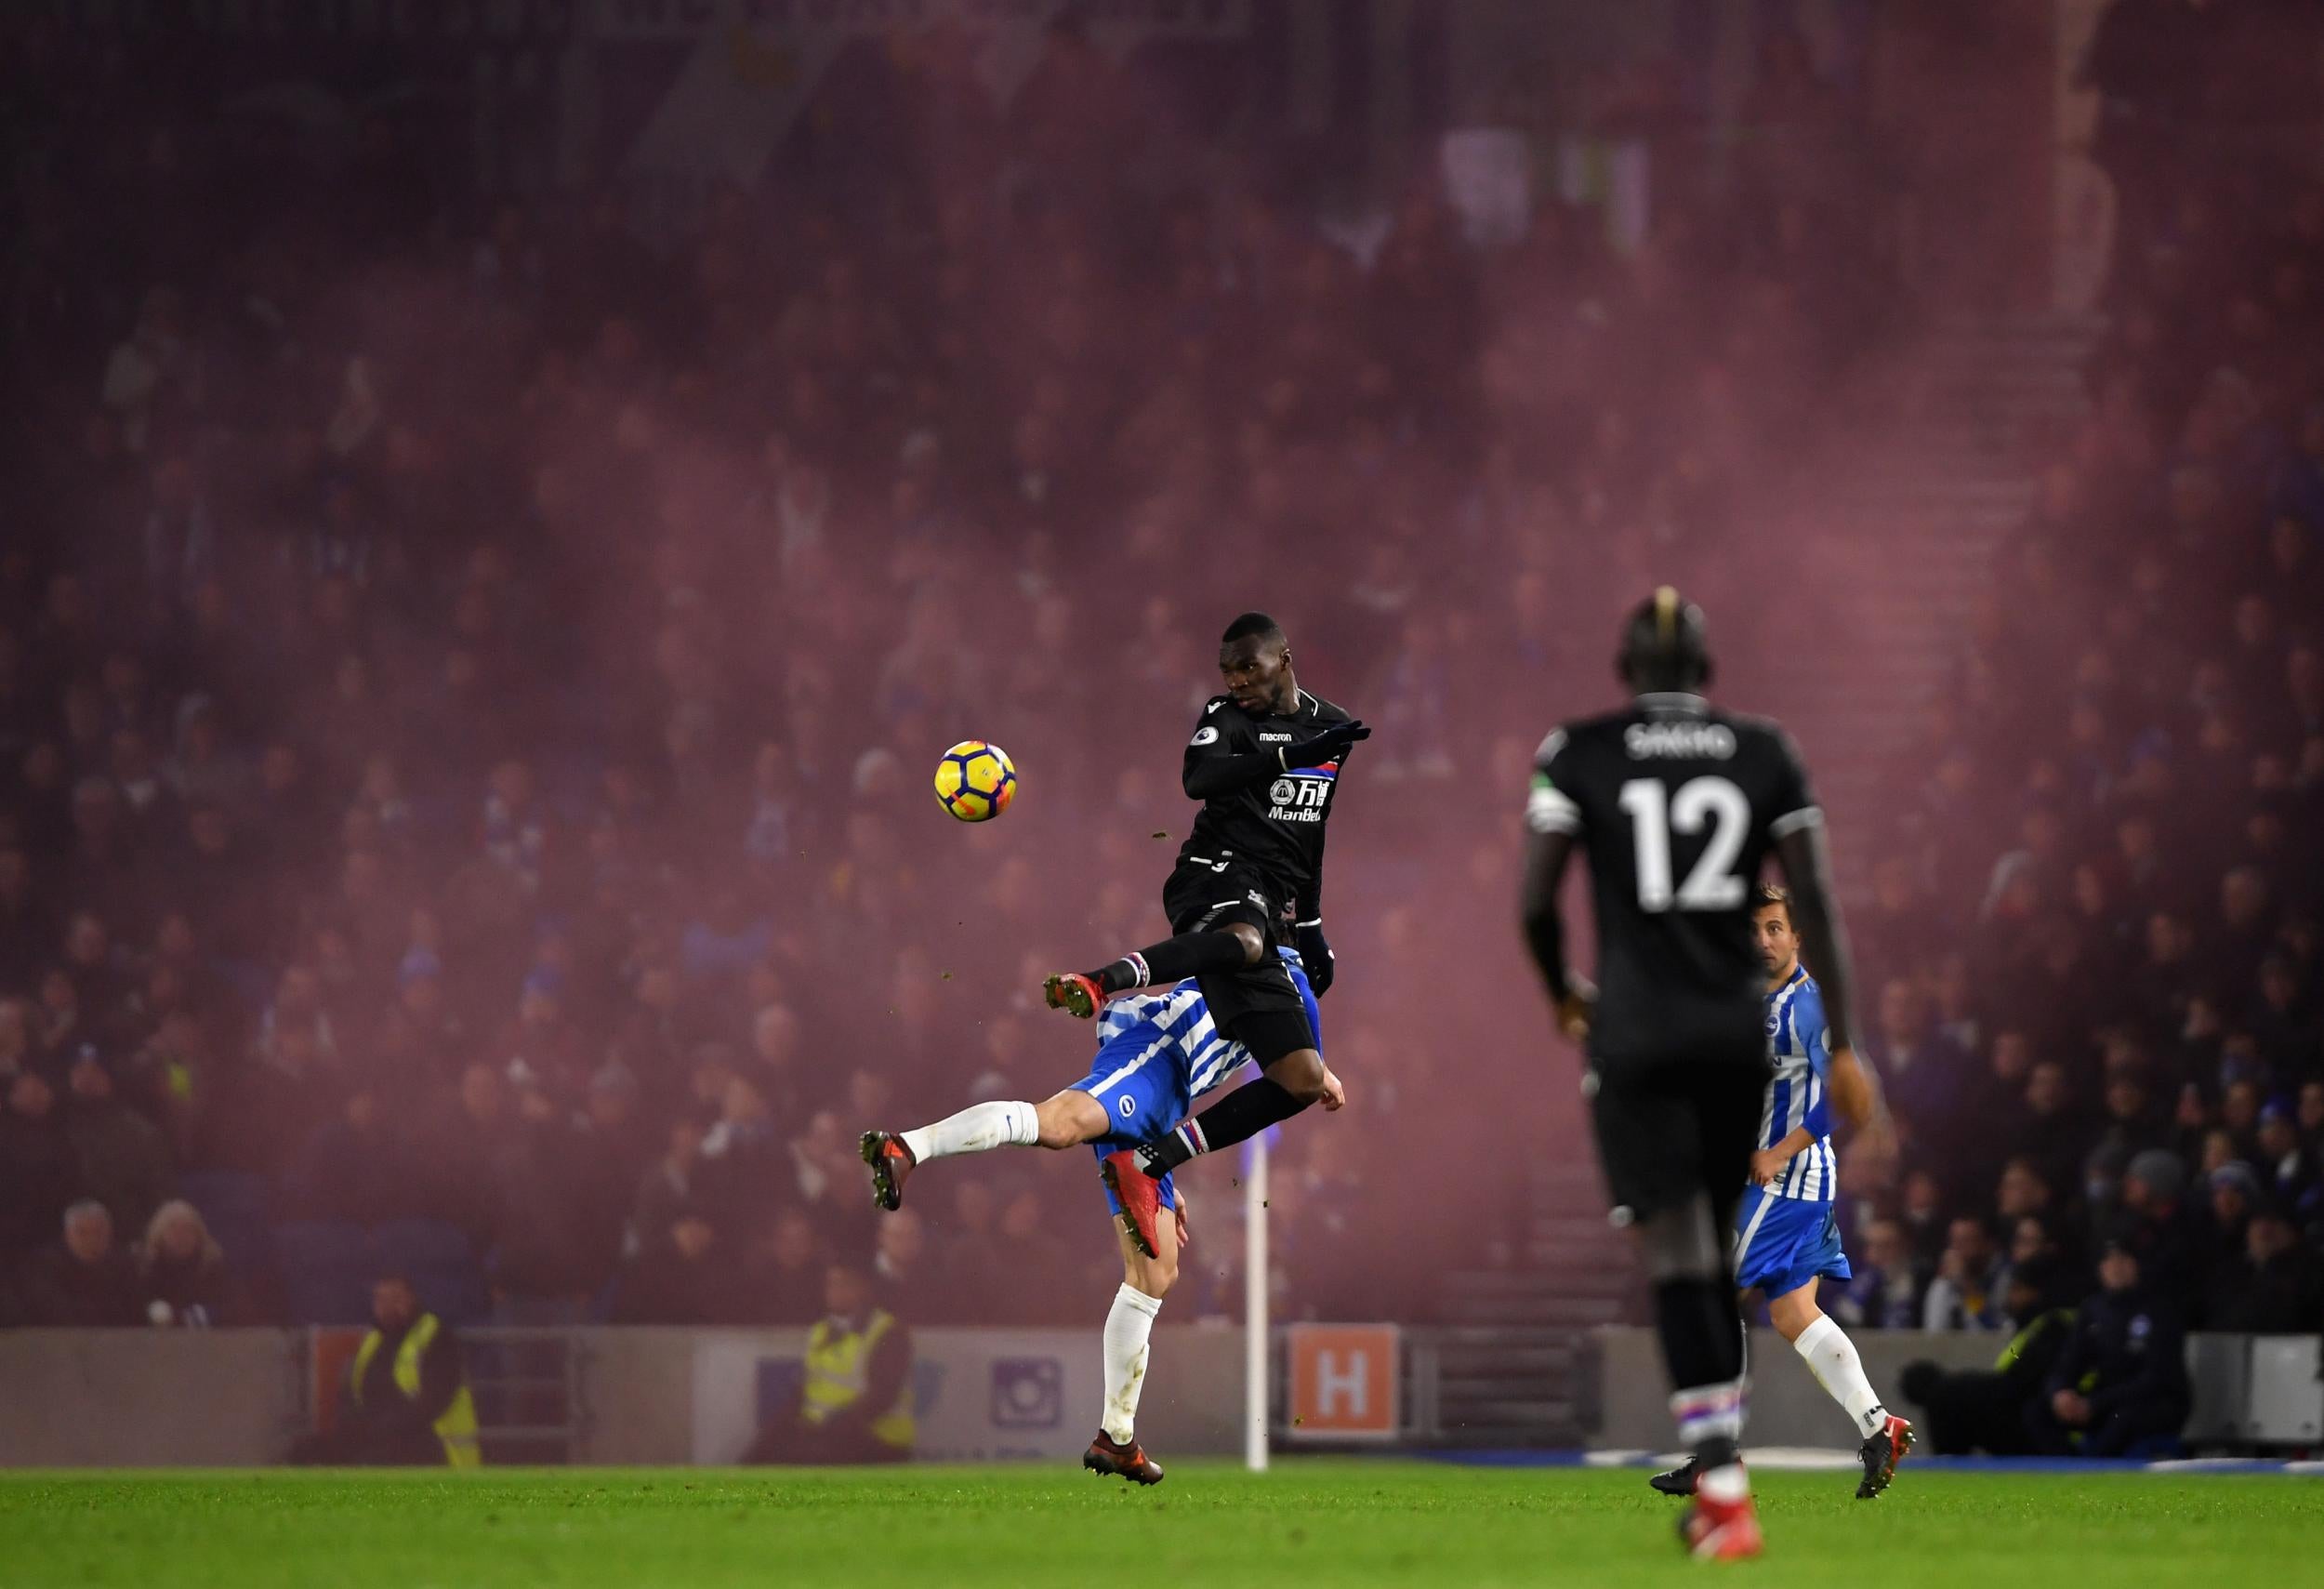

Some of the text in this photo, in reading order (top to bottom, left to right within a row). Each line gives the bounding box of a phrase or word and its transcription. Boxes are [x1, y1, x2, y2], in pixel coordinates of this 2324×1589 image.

[1260, 733, 1292, 742] macron
[1619, 775, 1753, 913] 12
[1317, 1349, 1368, 1418] H
